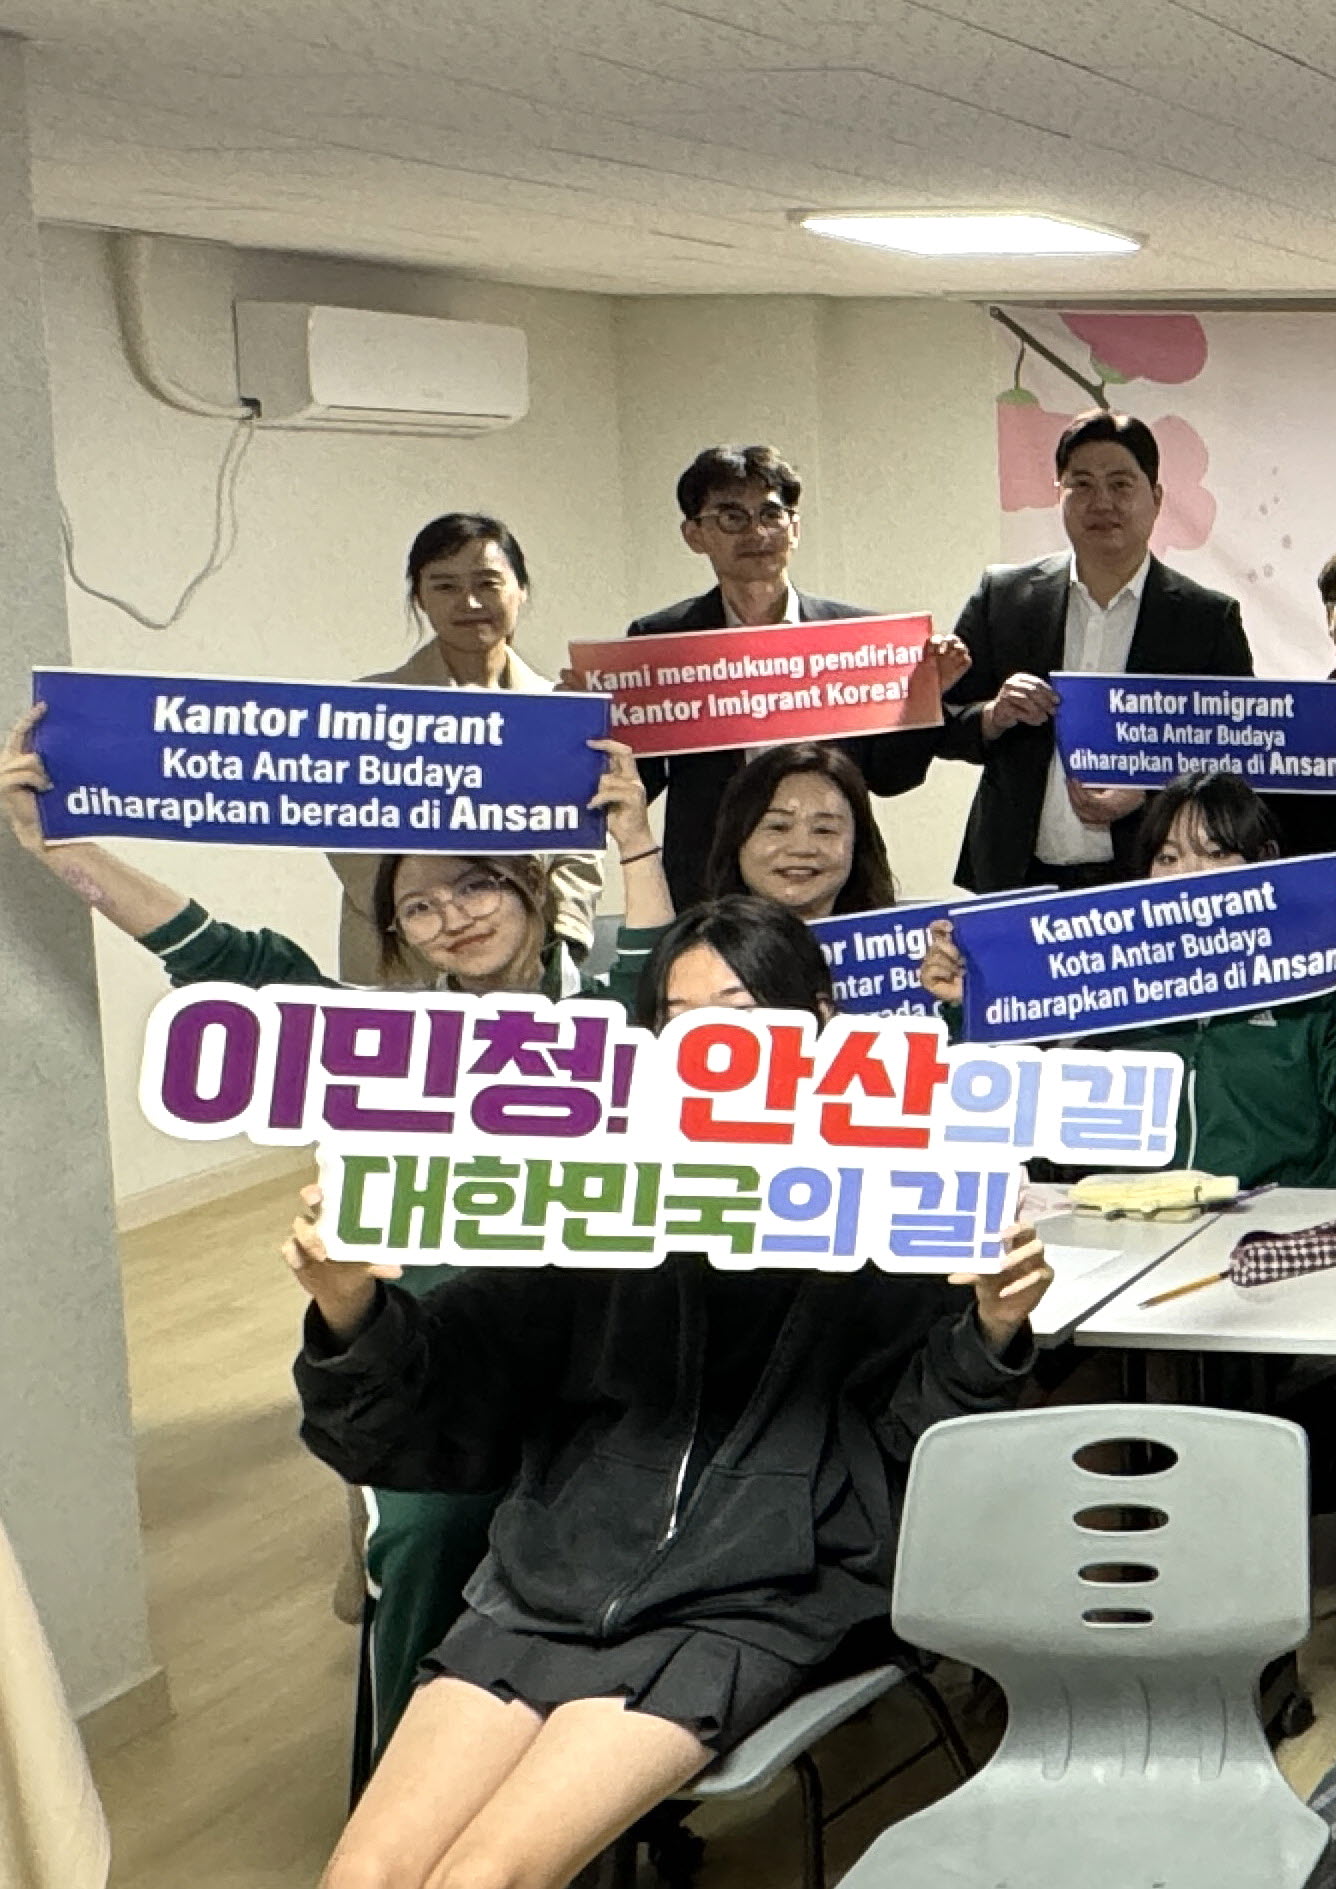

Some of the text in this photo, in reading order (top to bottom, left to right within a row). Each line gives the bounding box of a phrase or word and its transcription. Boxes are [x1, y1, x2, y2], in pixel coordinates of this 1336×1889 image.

[584, 643, 925, 693] Kami mendukung pendirian
[154, 696, 504, 750] Kantor Imigrant
[610, 677, 909, 727] Kantor Imigrant Korea!
[1109, 688, 1295, 720] Kantor Imigrant
[1069, 749, 1173, 774] diharapkan
[1178, 753, 1243, 776] berada
[1247, 754, 1265, 776] di
[1116, 725, 1286, 750] Kota Antar Budaya
[163, 747, 484, 796] Kota Antar Budaya
[67, 786, 580, 831] diharapkan berada di Ansan
[1030, 881, 1277, 946] Kantor Imigrant
[1048, 922, 1274, 981] Kota Antar Budaya
[985, 984, 1128, 1025] diharapkan
[1133, 968, 1220, 1003] berada
[1224, 960, 1247, 991] di
[160, 1000, 1174, 1151] 이민청! 안산의 길!
[336, 1154, 1010, 1260] 대한민국의 길!
